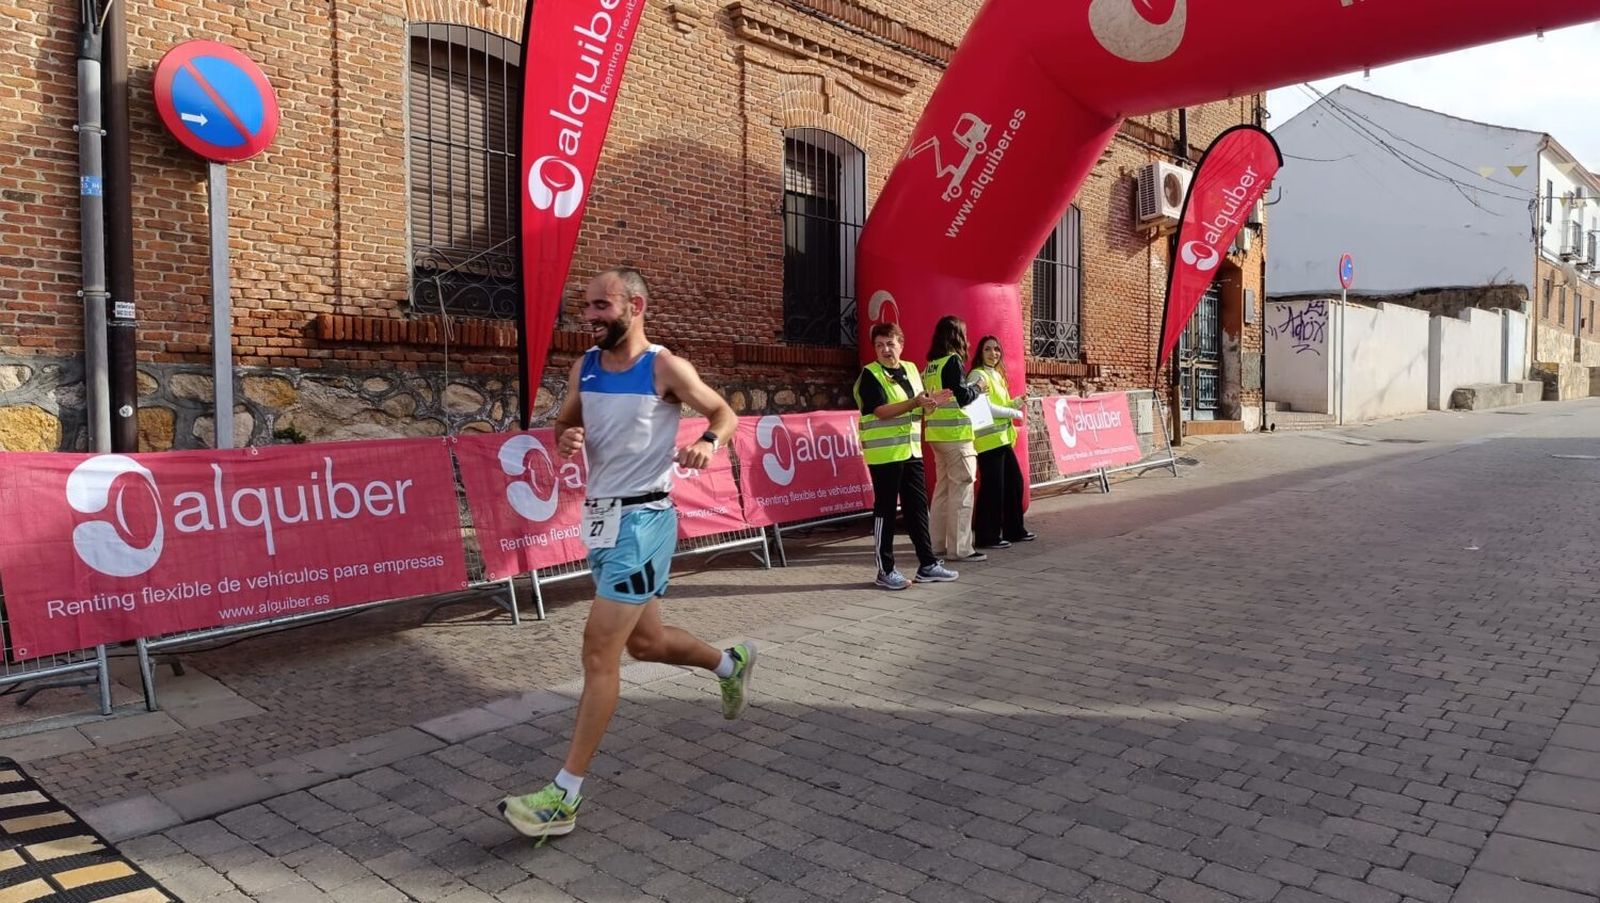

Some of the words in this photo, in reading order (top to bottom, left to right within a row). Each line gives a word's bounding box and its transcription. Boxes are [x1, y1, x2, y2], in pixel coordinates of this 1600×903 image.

[600, 43, 624, 95] Renting
[945, 108, 1026, 238] www.alquiber.es
[1201, 165, 1258, 244] alquiber
[1075, 400, 1122, 442] alquiber
[173, 457, 413, 556] alquiber
[756, 494, 789, 507] Renting
[789, 489, 816, 502] flexible
[817, 488, 827, 498] de
[500, 533, 548, 552] Renting
[550, 524, 583, 541] flexibl
[589, 520, 605, 537] 27
[47, 594, 136, 619] Renting
[142, 581, 212, 604] flexible
[217, 577, 241, 593] de
[246, 567, 329, 589] vehículos
[333, 562, 368, 582] para
[373, 554, 445, 574] empresas
[218, 593, 330, 620] www.alquiber.es
